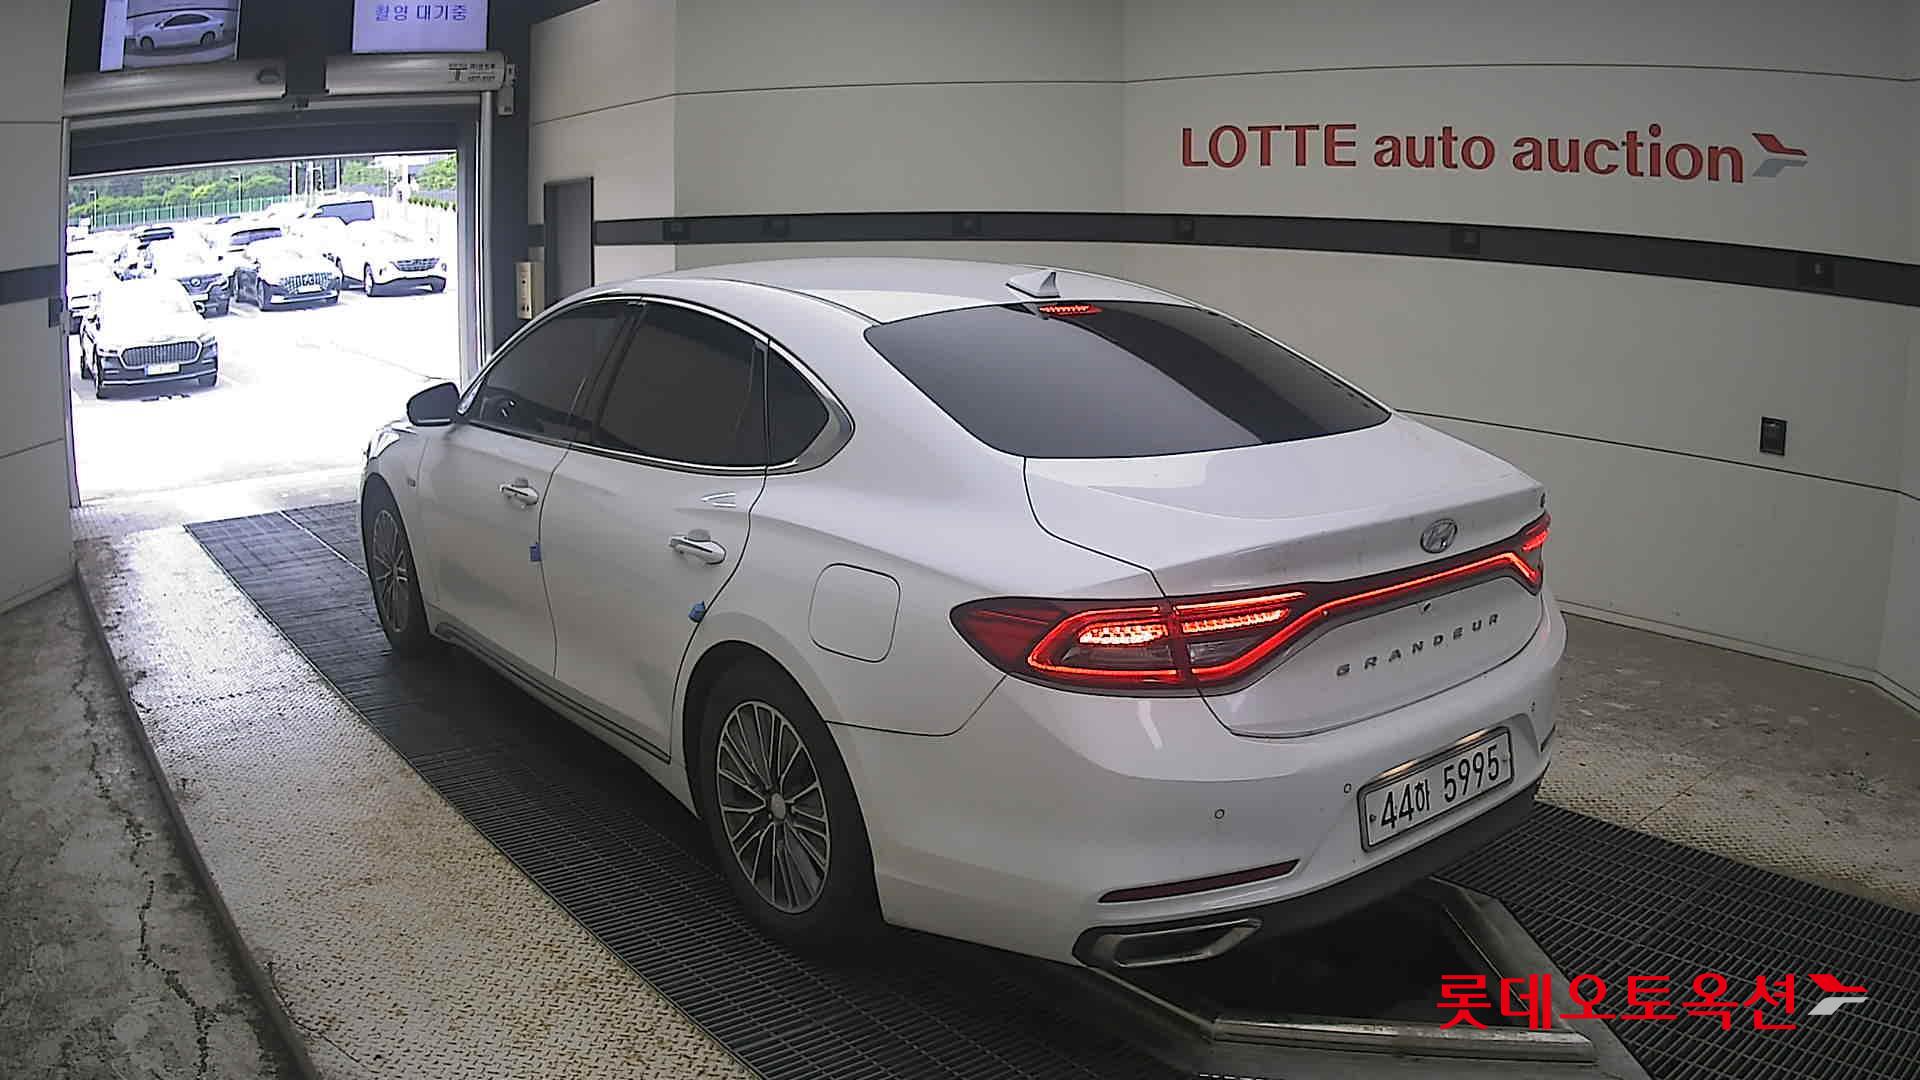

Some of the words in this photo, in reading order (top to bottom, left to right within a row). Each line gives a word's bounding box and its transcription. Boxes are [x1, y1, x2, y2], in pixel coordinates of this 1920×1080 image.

[416, 4, 467, 21] 대기중
[1182, 123, 1357, 168] LOTTE
[1373, 126, 1496, 170] auto
[1512, 123, 1744, 184] auction
[1336, 613, 1499, 677] GRANDEUR
[1380, 779, 1431, 829] 44하
[1443, 744, 1500, 803] 5995
